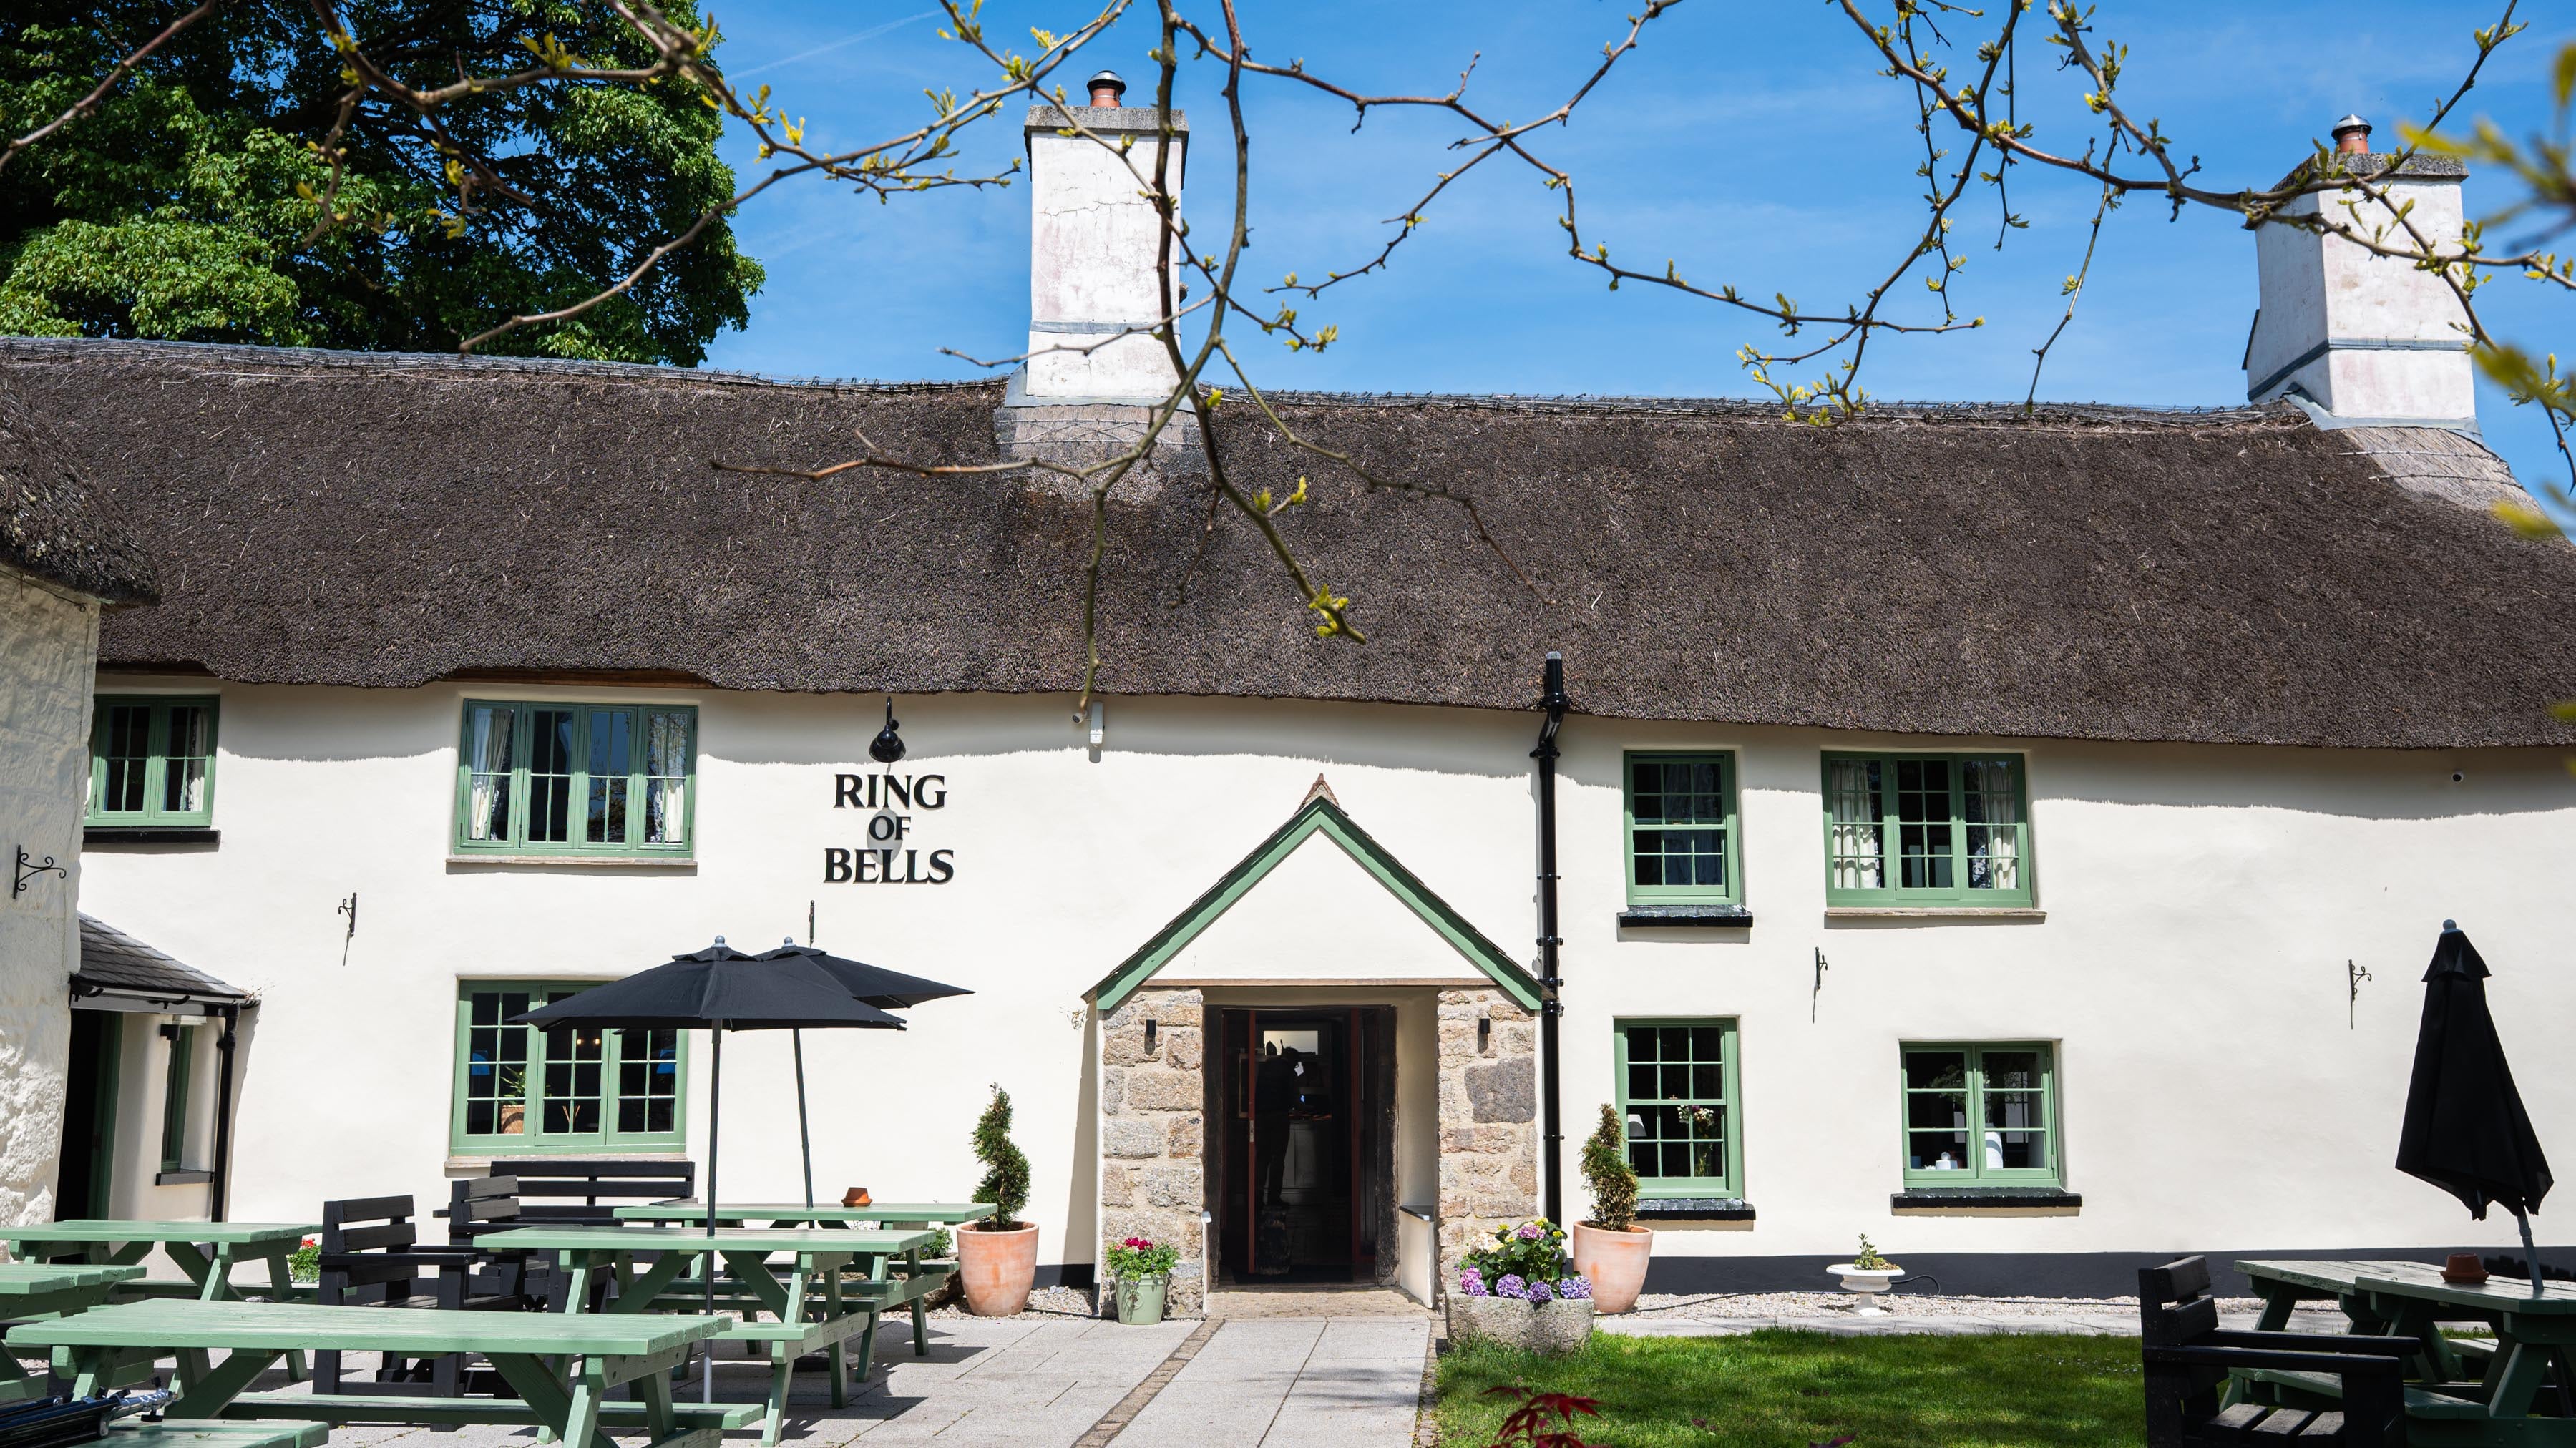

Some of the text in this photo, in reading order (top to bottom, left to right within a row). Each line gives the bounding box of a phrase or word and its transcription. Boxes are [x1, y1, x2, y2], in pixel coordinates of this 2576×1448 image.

[833, 773, 947, 810] RING
[868, 815, 912, 841] OF
[823, 848, 954, 884] BELLS
